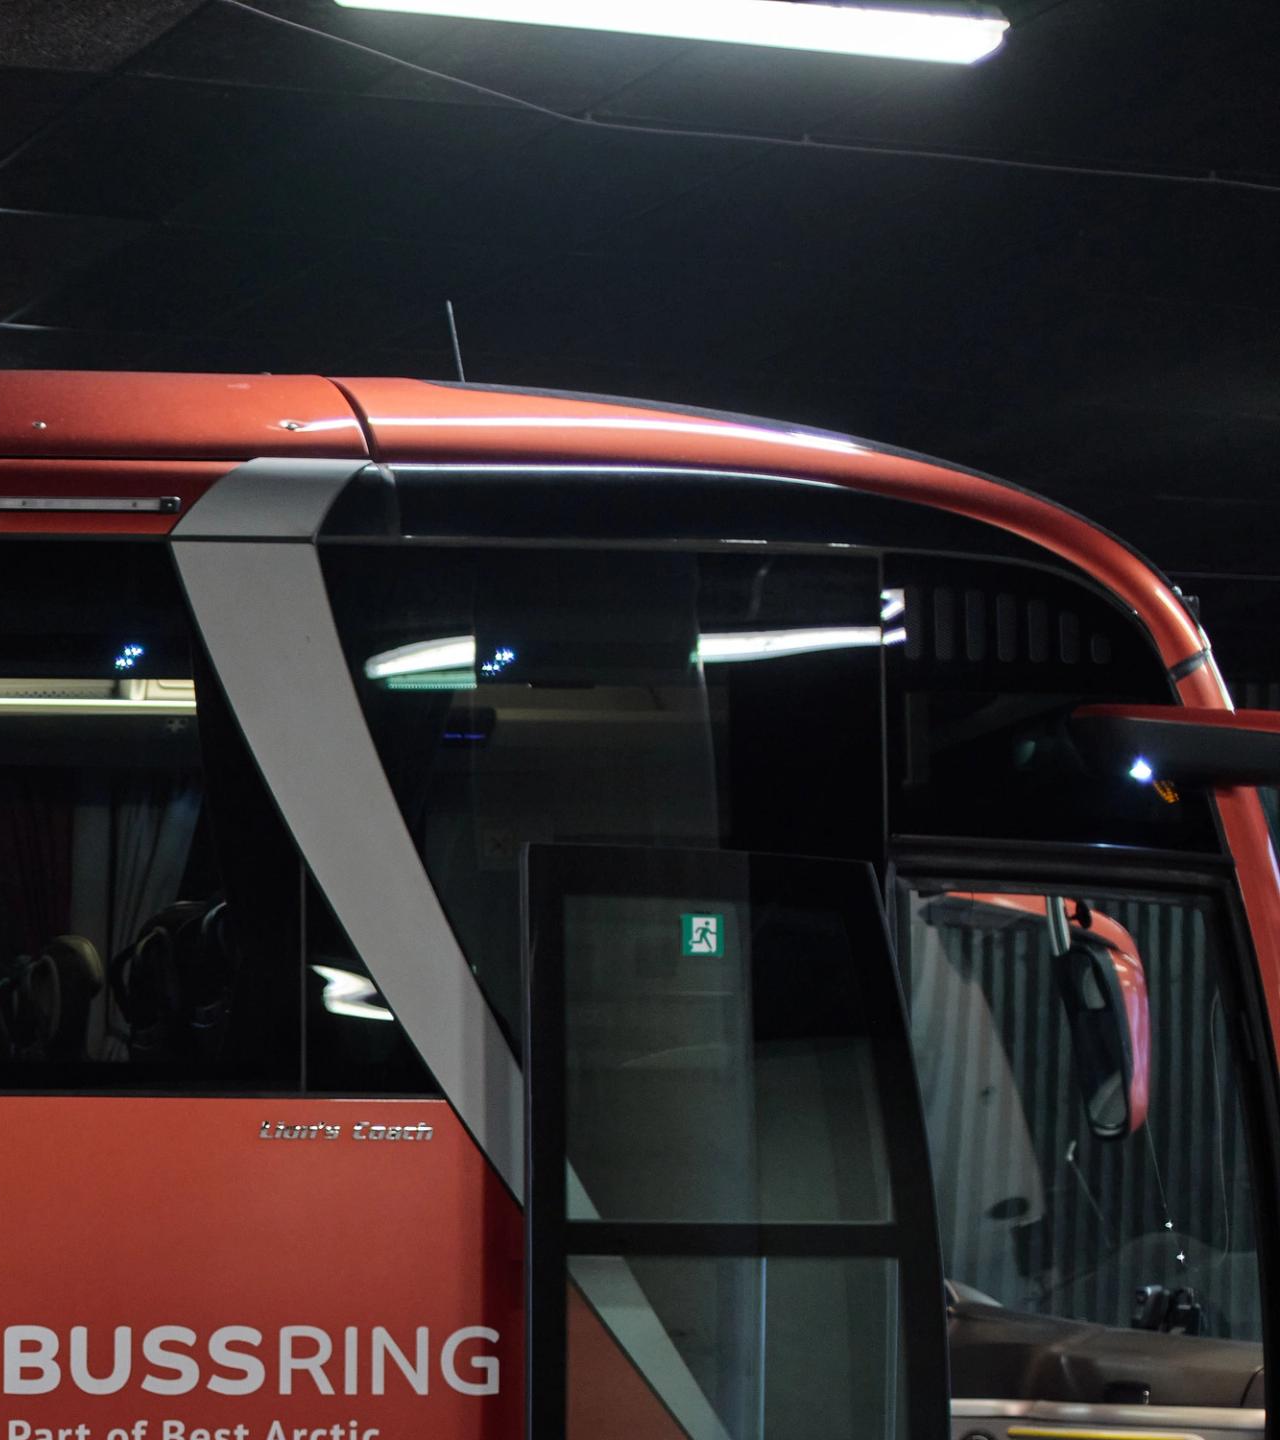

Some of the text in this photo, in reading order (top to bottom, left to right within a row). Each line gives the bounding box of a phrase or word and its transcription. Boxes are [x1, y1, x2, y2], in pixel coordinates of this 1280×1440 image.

[259, 1120, 434, 1141] Lion's Coach
[3, 1324, 501, 1396] BUSSRING
